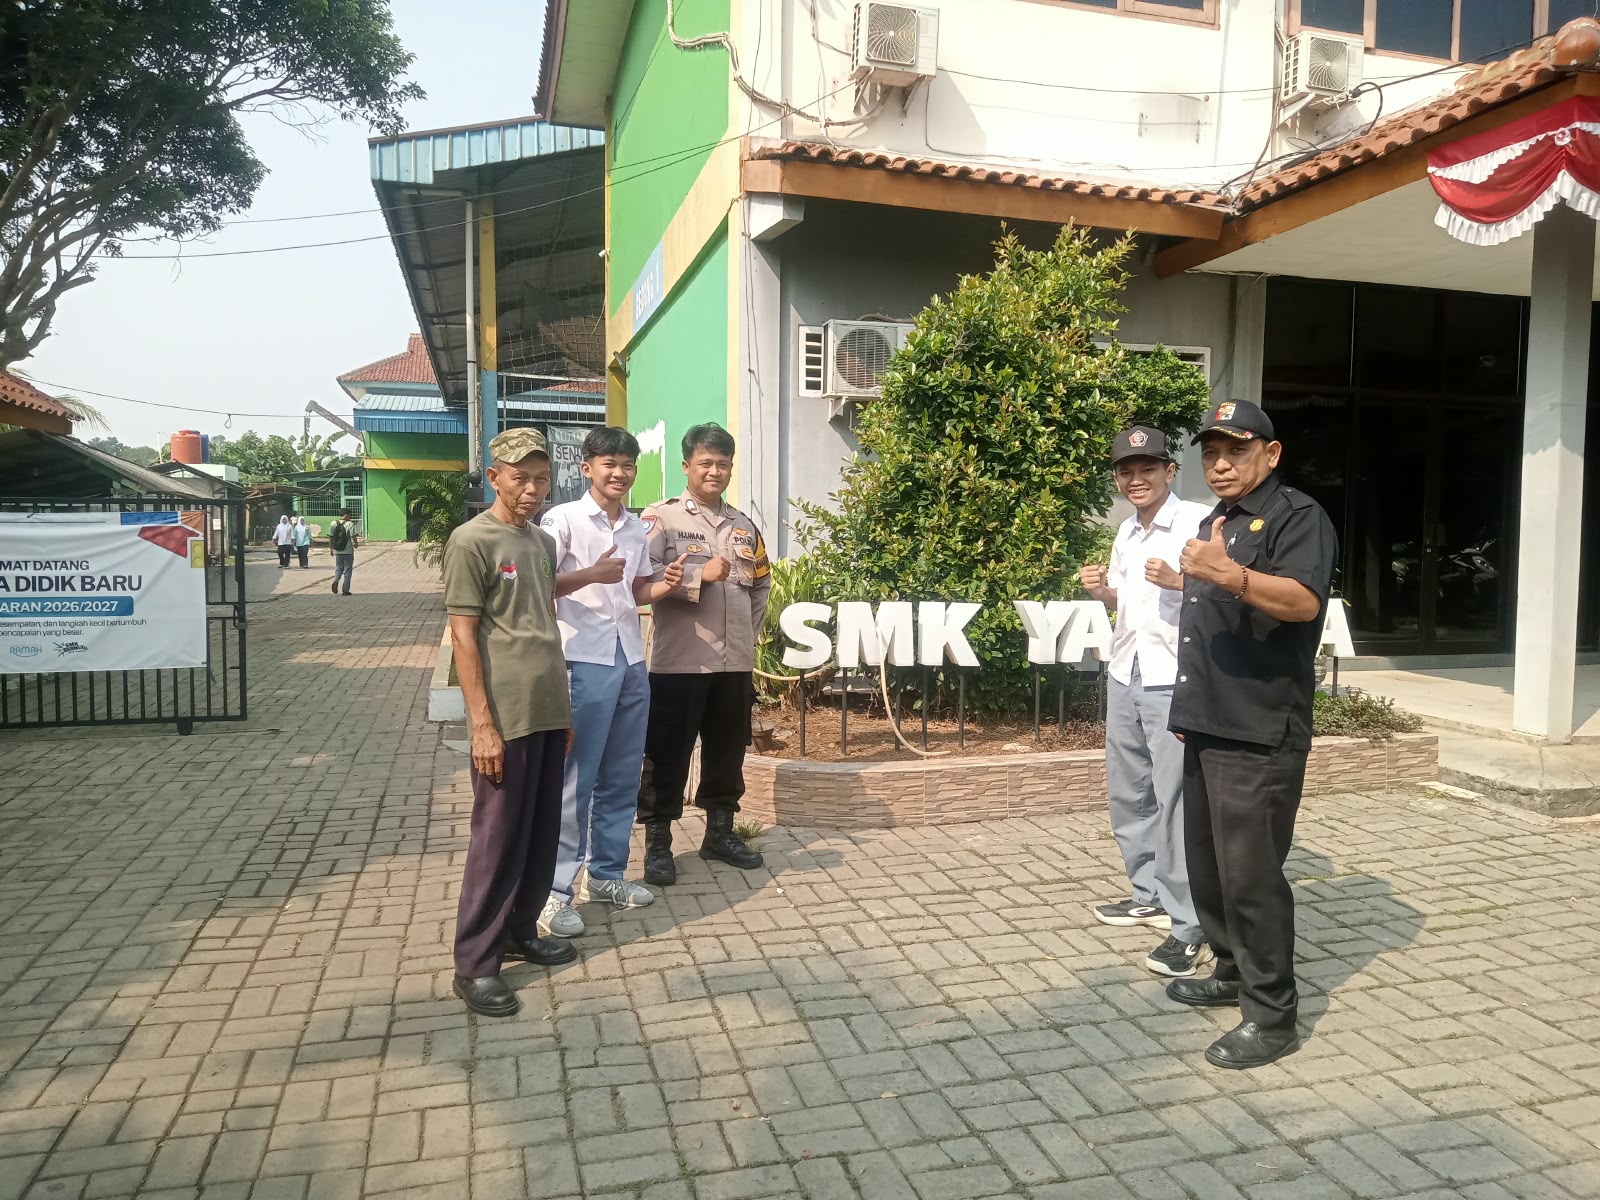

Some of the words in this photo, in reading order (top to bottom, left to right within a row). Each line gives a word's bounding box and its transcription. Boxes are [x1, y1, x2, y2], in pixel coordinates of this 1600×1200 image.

[0, 560, 31, 571] MAT
[33, 560, 90, 571] DATANG
[15, 575, 77, 592] DIDIK
[80, 575, 142, 592] BARU
[0, 601, 42, 613] ARAN
[43, 600, 119, 613] 2026/2027
[43, 619, 58, 628] dan
[59, 619, 88, 629] langkah
[89, 619, 106, 627] kecil
[42, 629, 62, 637] yang
[62, 628, 84, 636] besar.
[779, 601, 983, 668] SMK
[9, 645, 42, 656] RAMAH
